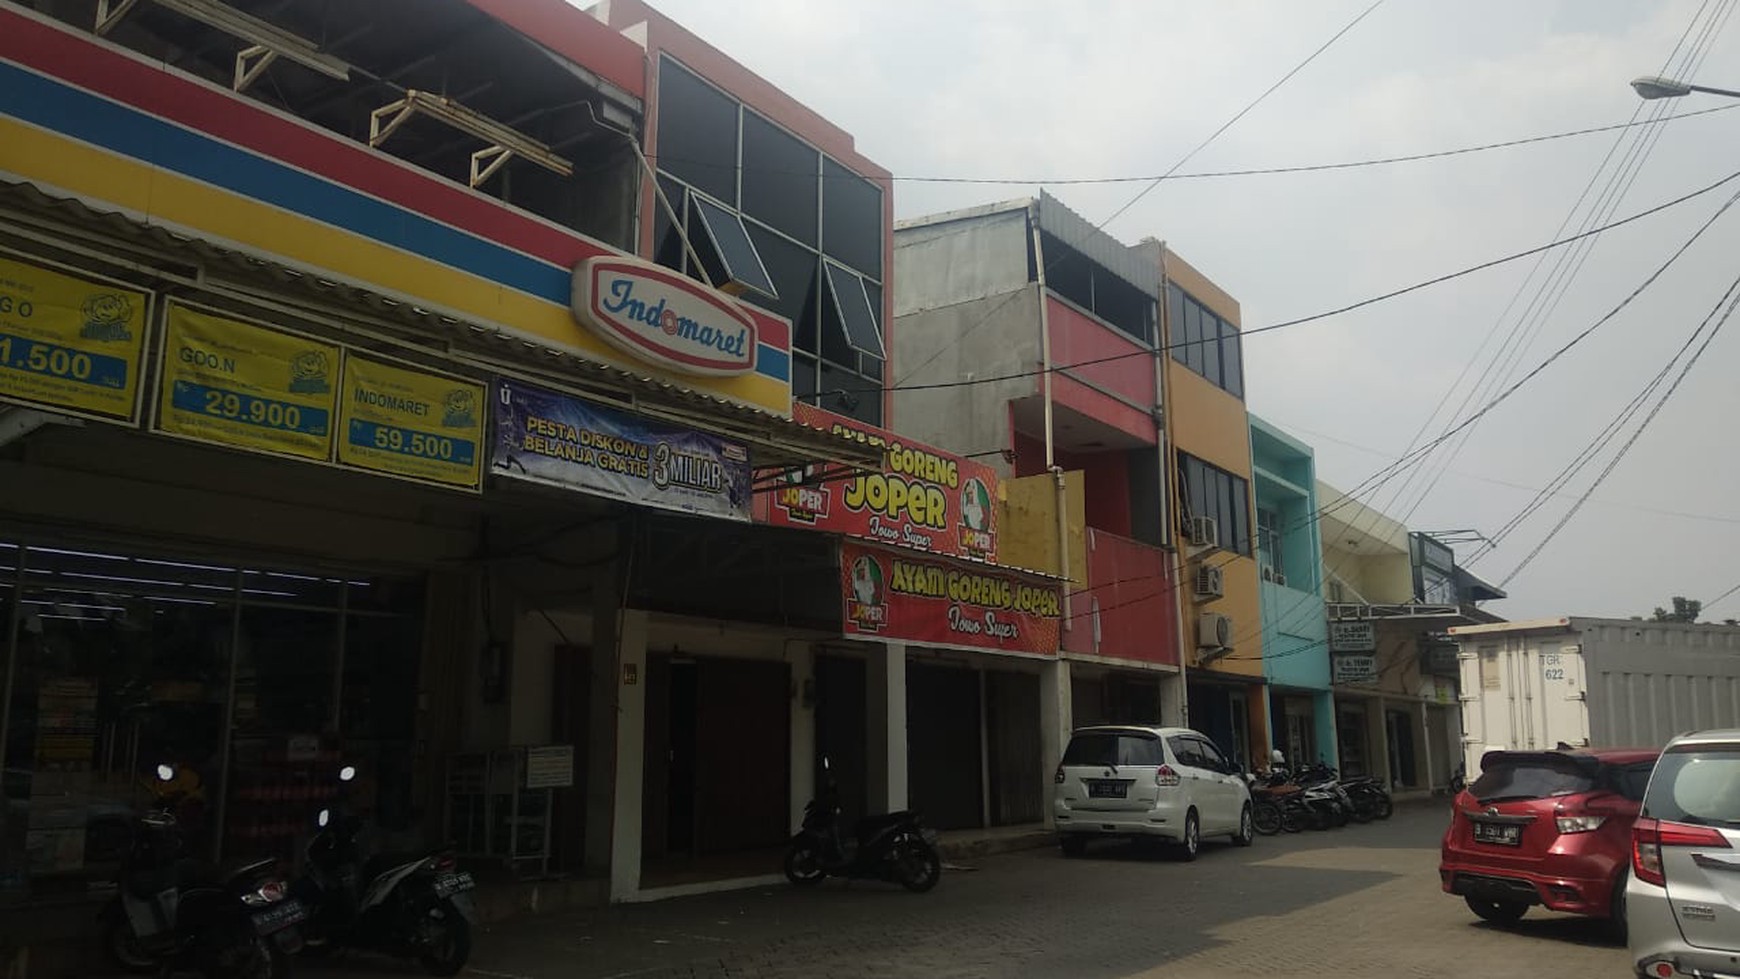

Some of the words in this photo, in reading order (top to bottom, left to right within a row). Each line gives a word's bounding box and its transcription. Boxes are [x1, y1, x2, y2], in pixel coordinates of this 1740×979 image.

[603, 280, 746, 357] Indomaret
[179, 347, 236, 374] GOO.N
[205, 391, 300, 430] 29.900
[354, 388, 431, 417] INDOMARET
[374, 426, 453, 459] 59.500
[527, 416, 577, 443] PESTA
[581, 429, 637, 458] DISKON
[638, 445, 650, 461] &
[524, 435, 596, 467] BELANJA
[599, 453, 650, 479] GRATIS
[653, 442, 670, 488] 3
[671, 453, 723, 490] MILIAR
[890, 443, 958, 489] GORENG
[782, 487, 822, 511] JOPER
[902, 523, 932, 547] Super
[962, 532, 990, 549] JOPER
[890, 559, 946, 597] AYAM
[947, 570, 1010, 609] GORENG
[851, 604, 883, 622] JOPER
[984, 611, 1019, 642] Super
[1546, 669, 1564, 680] 622
